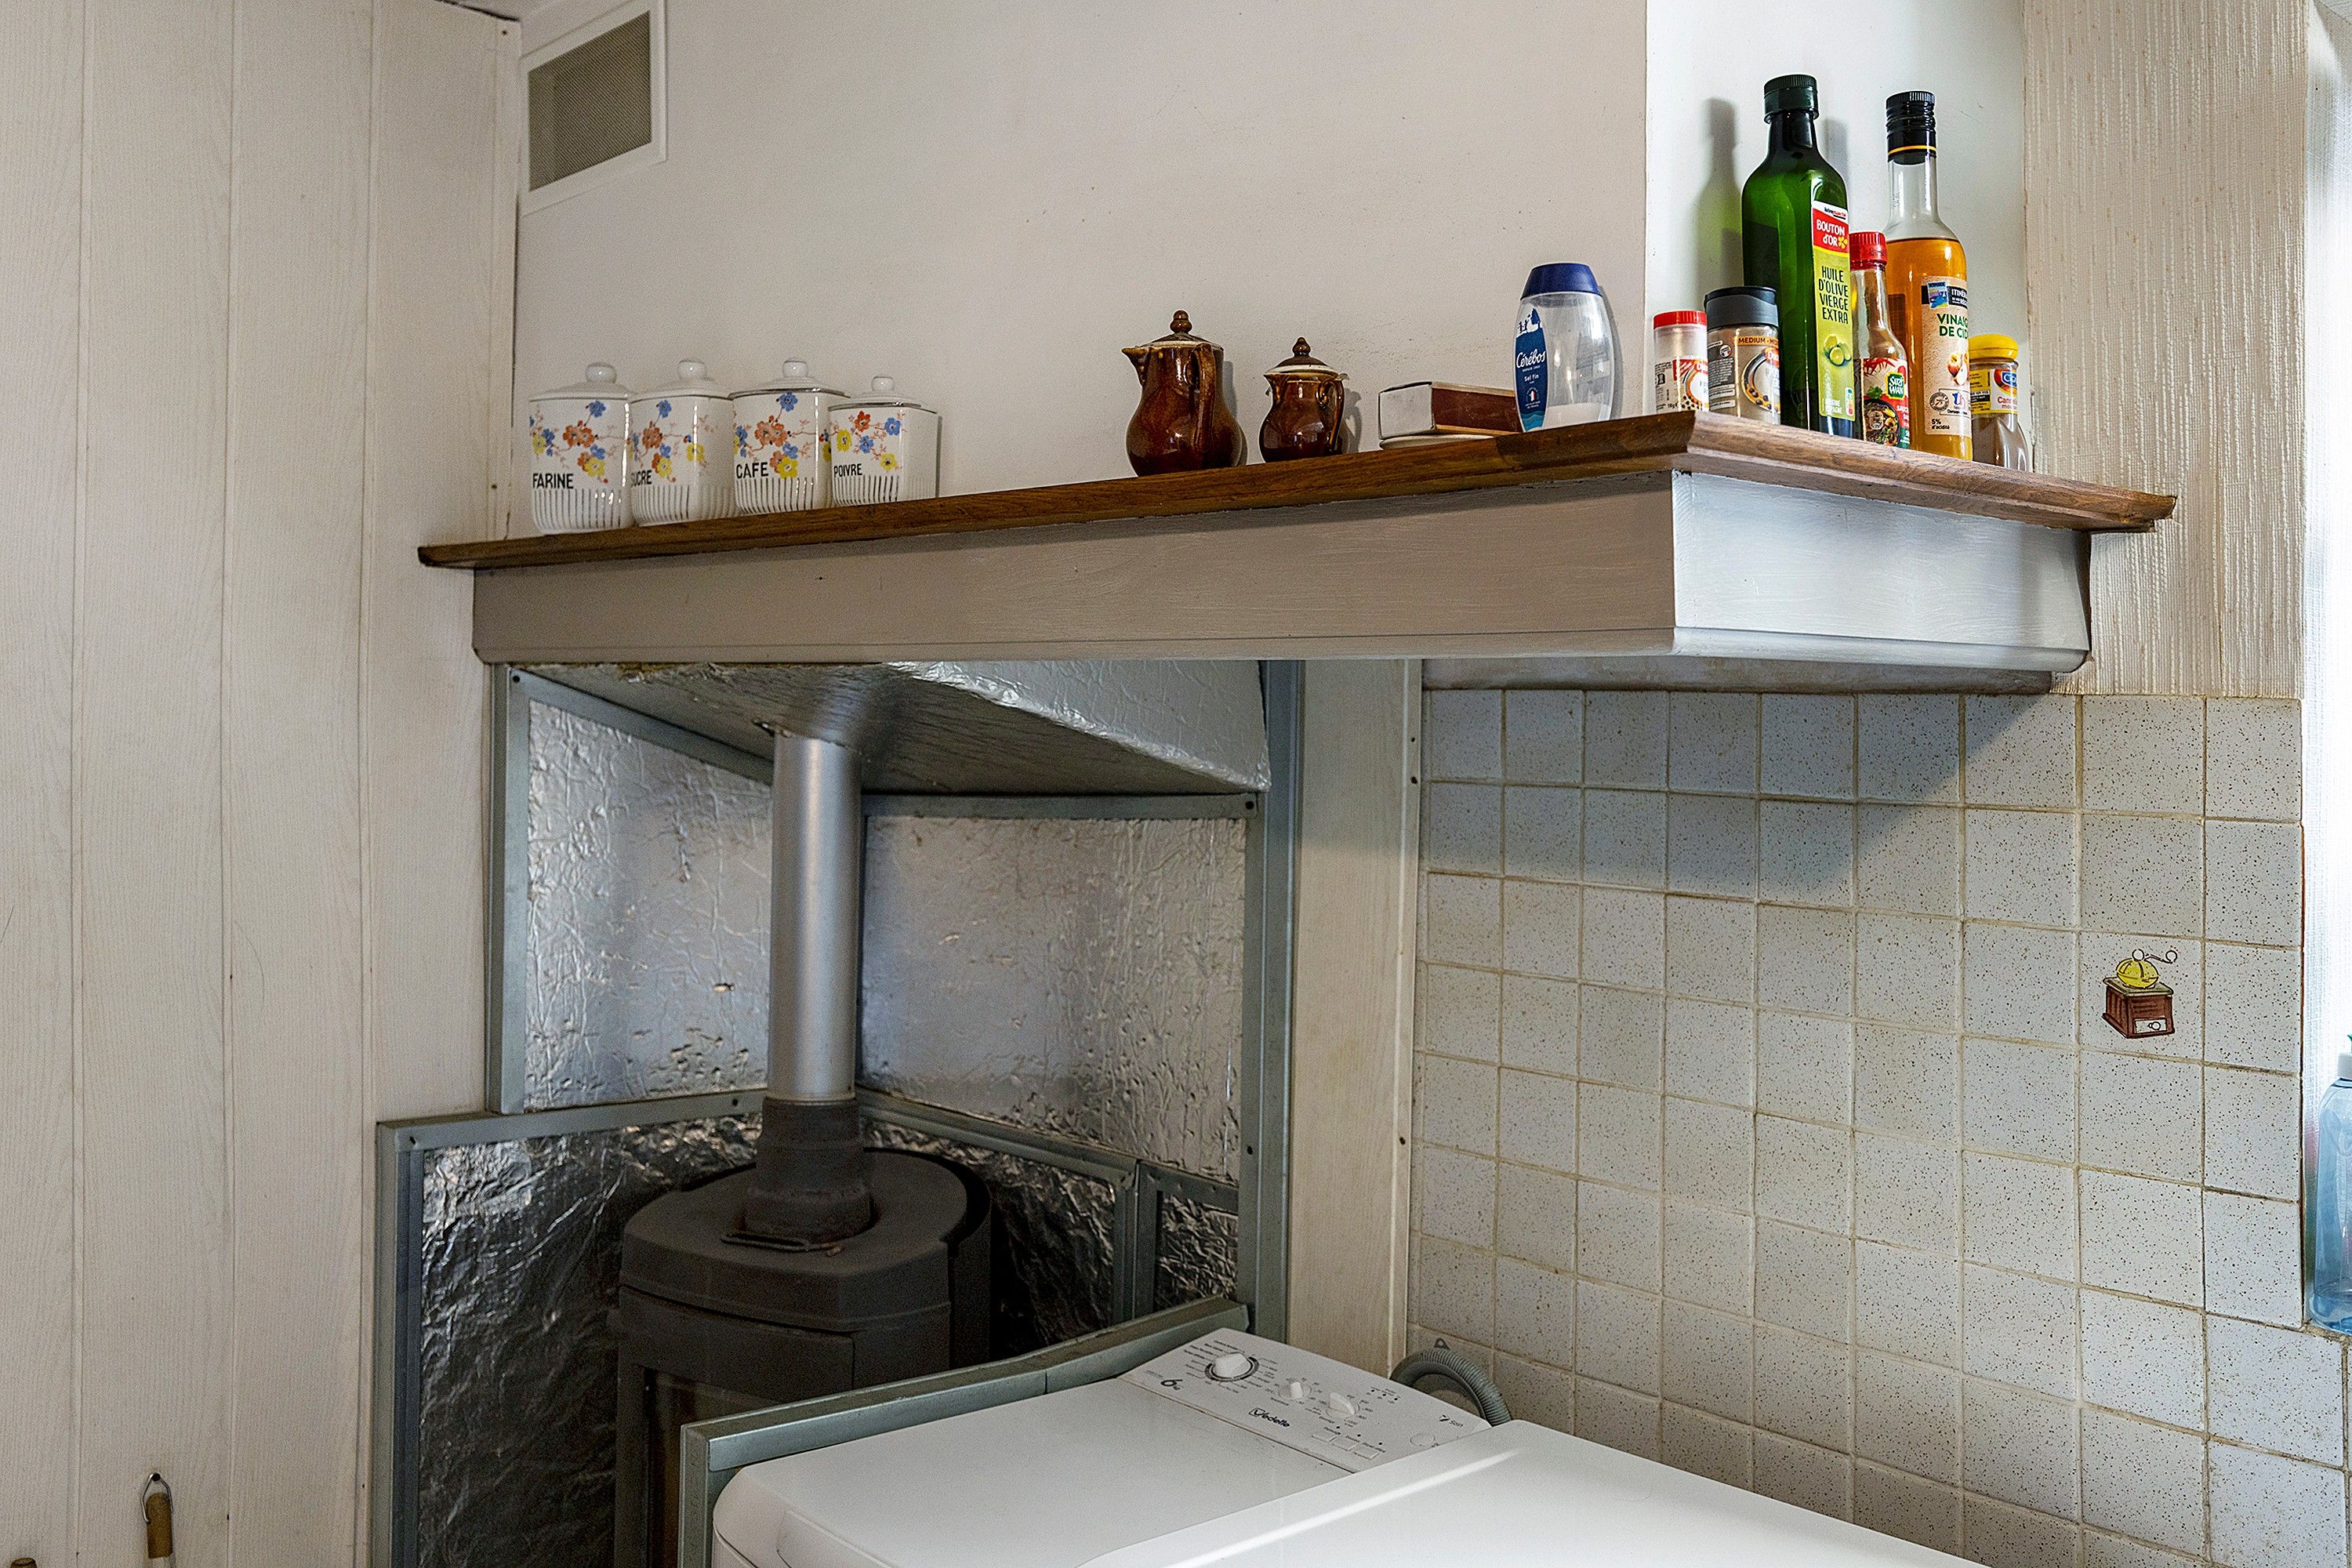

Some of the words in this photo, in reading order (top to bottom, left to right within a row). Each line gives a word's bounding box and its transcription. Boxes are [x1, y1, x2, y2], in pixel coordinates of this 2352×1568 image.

[1817, 219, 1845, 234] BOUTON
[1821, 266, 1844, 283] HUILE
[1819, 279, 1849, 298] D'OLIVE
[1819, 292, 1849, 311] VIERGE
[1823, 307, 1848, 325] EXTRA
[1940, 326, 1955, 336] DE
[1516, 348, 1546, 368] Cérébos
[736, 462, 769, 479] CAFE
[833, 463, 862, 477] POIVRE
[532, 473, 574, 489] FARINE
